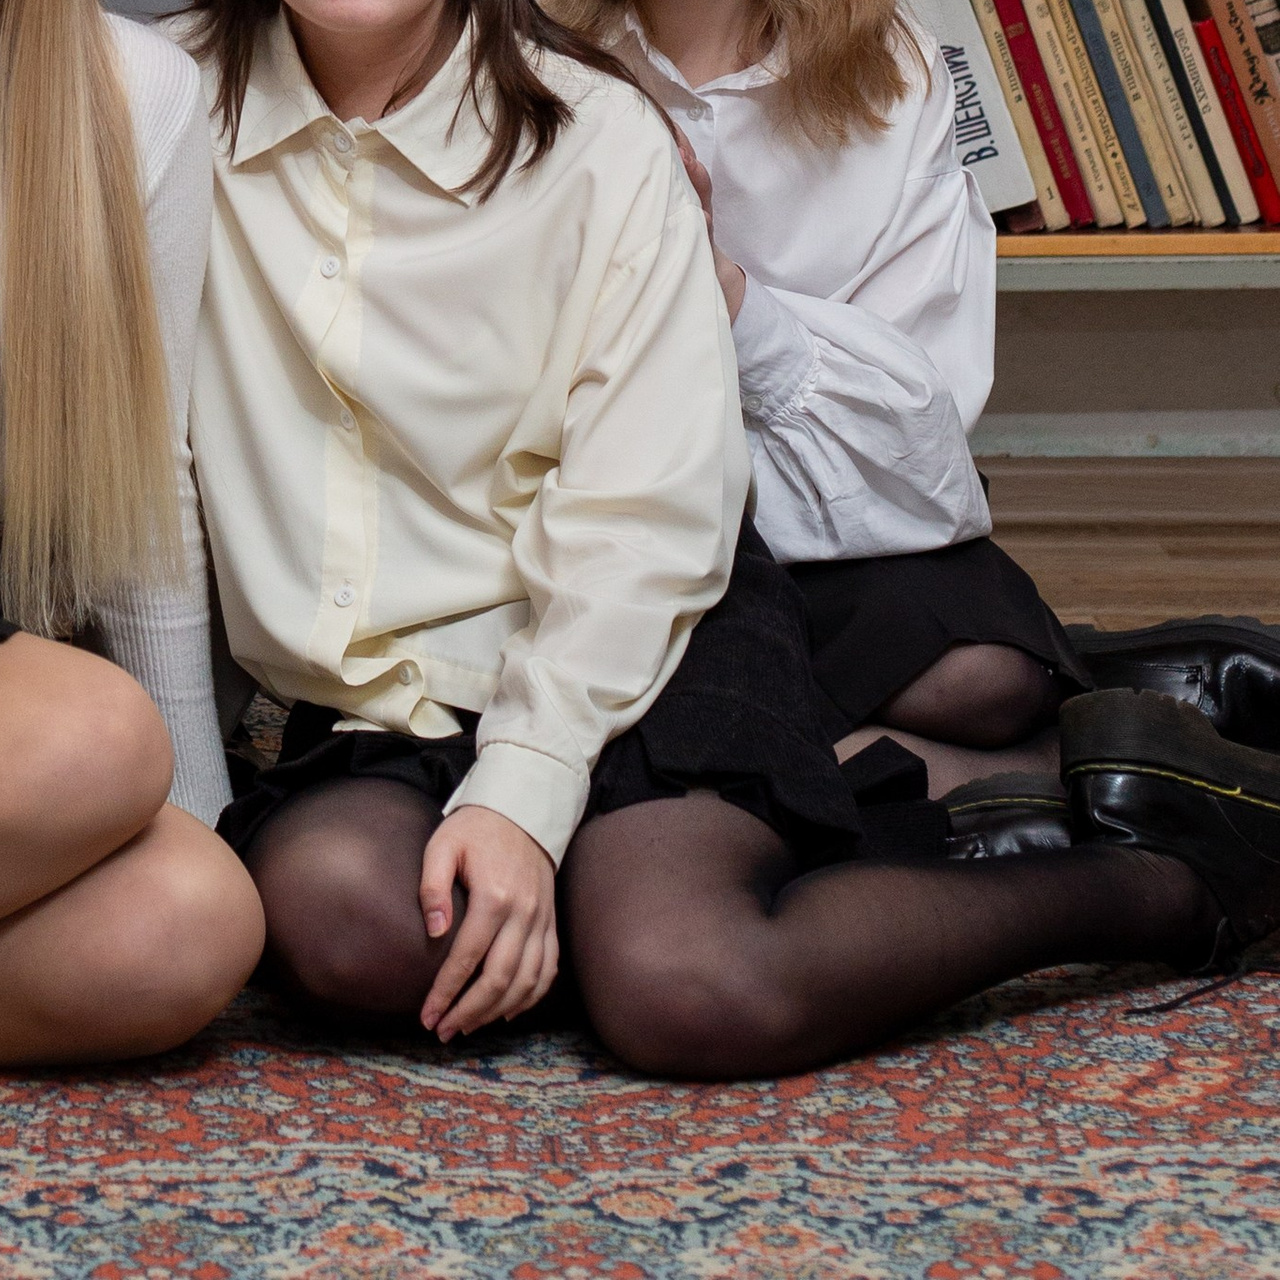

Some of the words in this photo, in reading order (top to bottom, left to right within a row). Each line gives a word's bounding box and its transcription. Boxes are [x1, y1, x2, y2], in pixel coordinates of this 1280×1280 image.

[1071, 44, 1098, 97] Шекспира
[1109, 28, 1138, 90] ШЕКСПИР
[1173, 27, 1208, 102] ХЕМИНГУЭЙ
[1089, 97, 1117, 151] Трагедия
